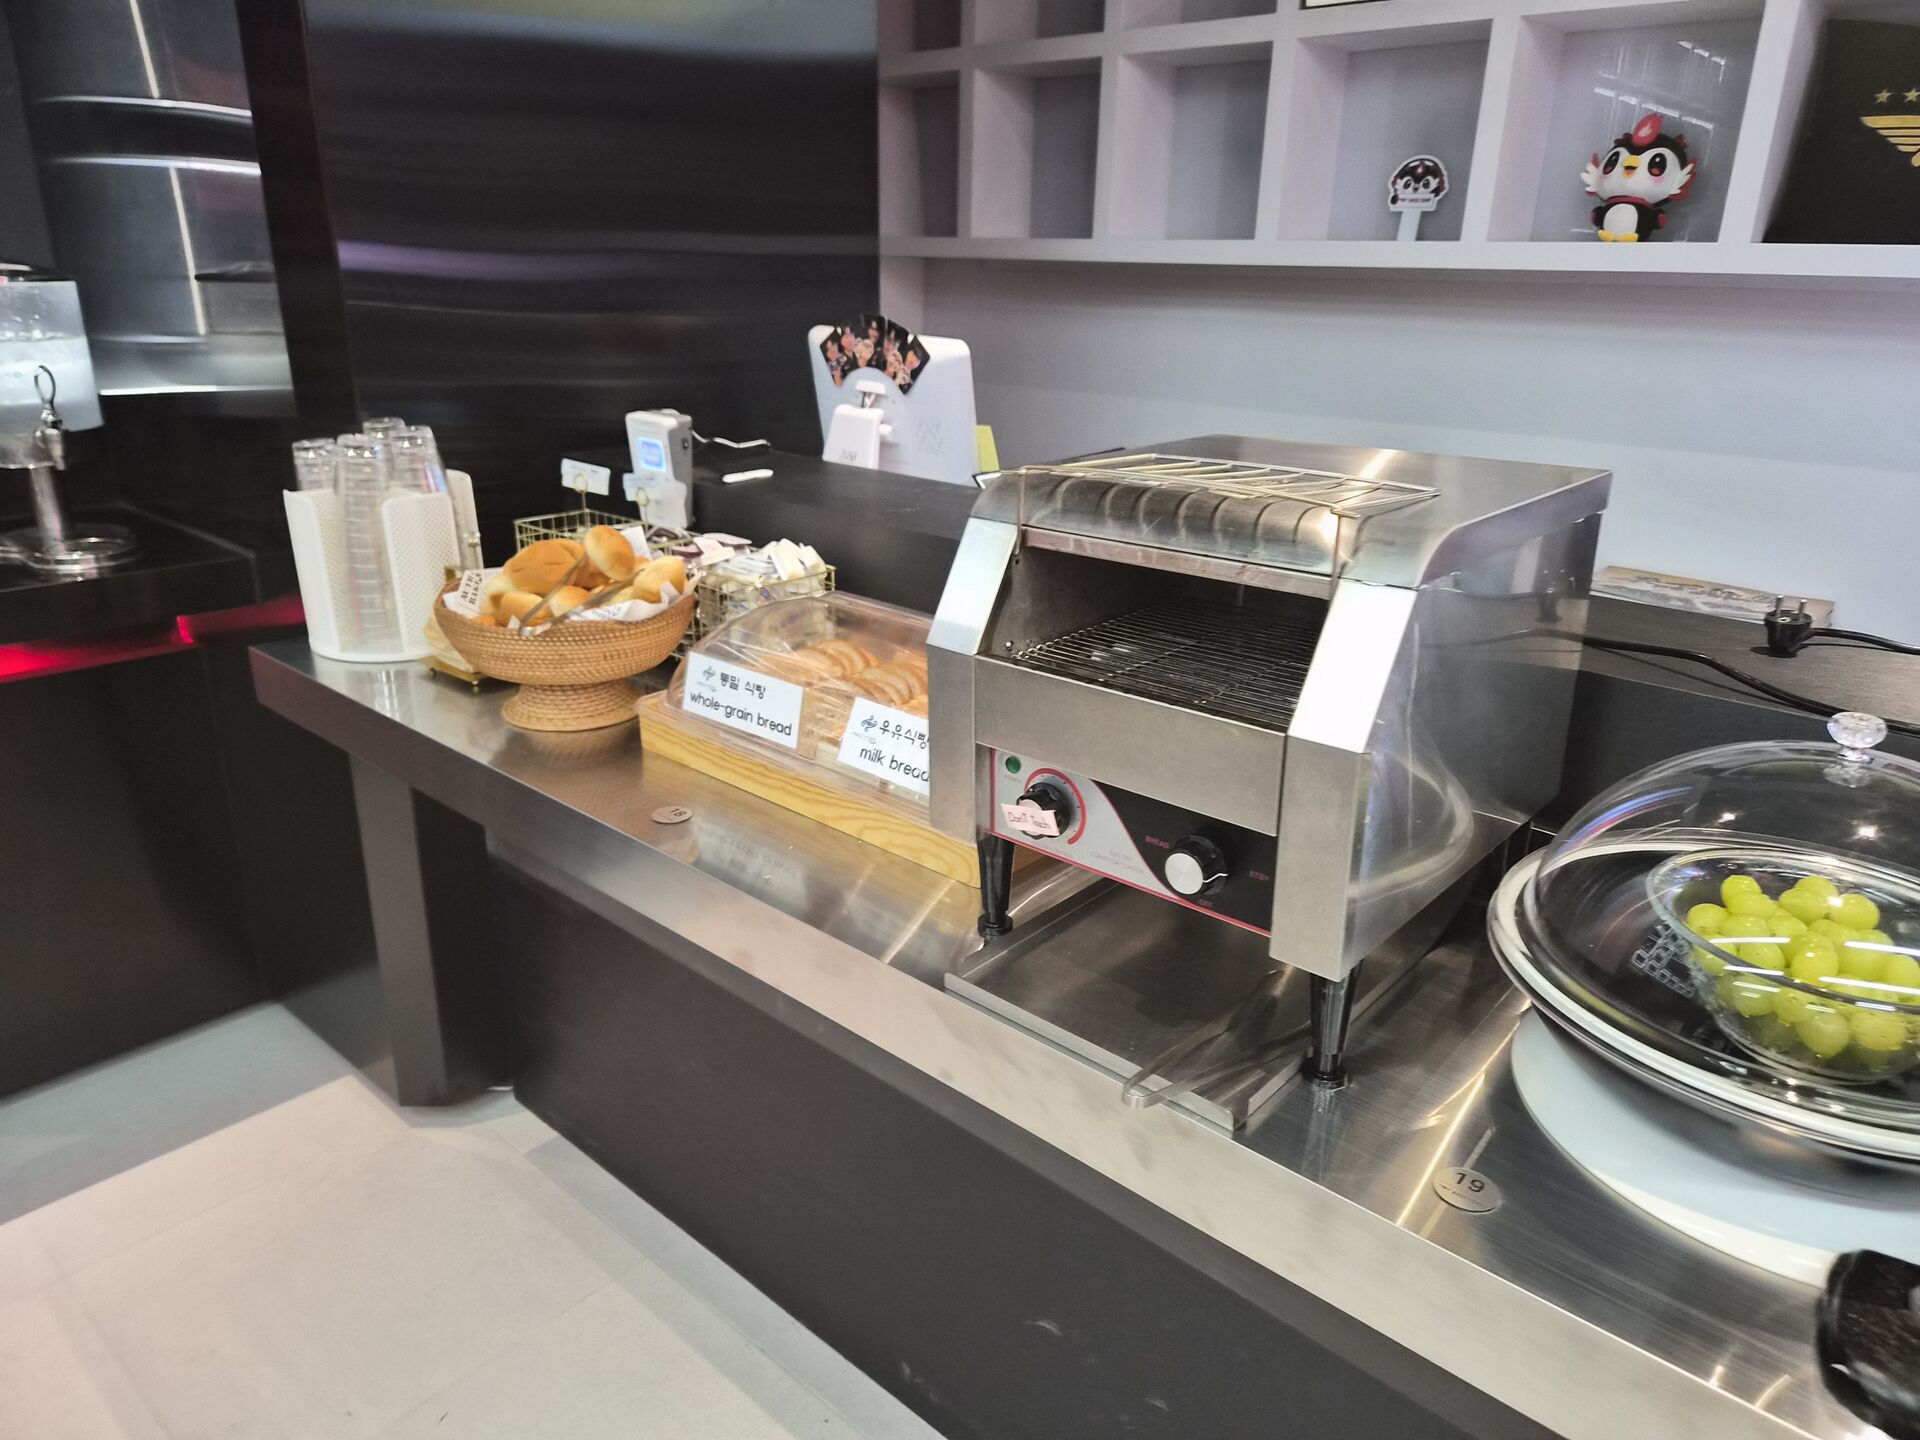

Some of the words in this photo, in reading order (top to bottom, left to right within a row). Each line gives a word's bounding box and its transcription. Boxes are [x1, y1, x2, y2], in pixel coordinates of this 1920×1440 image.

[720, 671, 740, 690] 통밀
[745, 680, 766, 699] 식빵
[690, 690, 753, 723] whole-grain
[757, 714, 792, 736] bread
[879, 719, 929, 750] 우유식빵
[860, 746, 886, 766] milk
[669, 808, 687, 817] 18
[1456, 1172, 1485, 1193] 19
